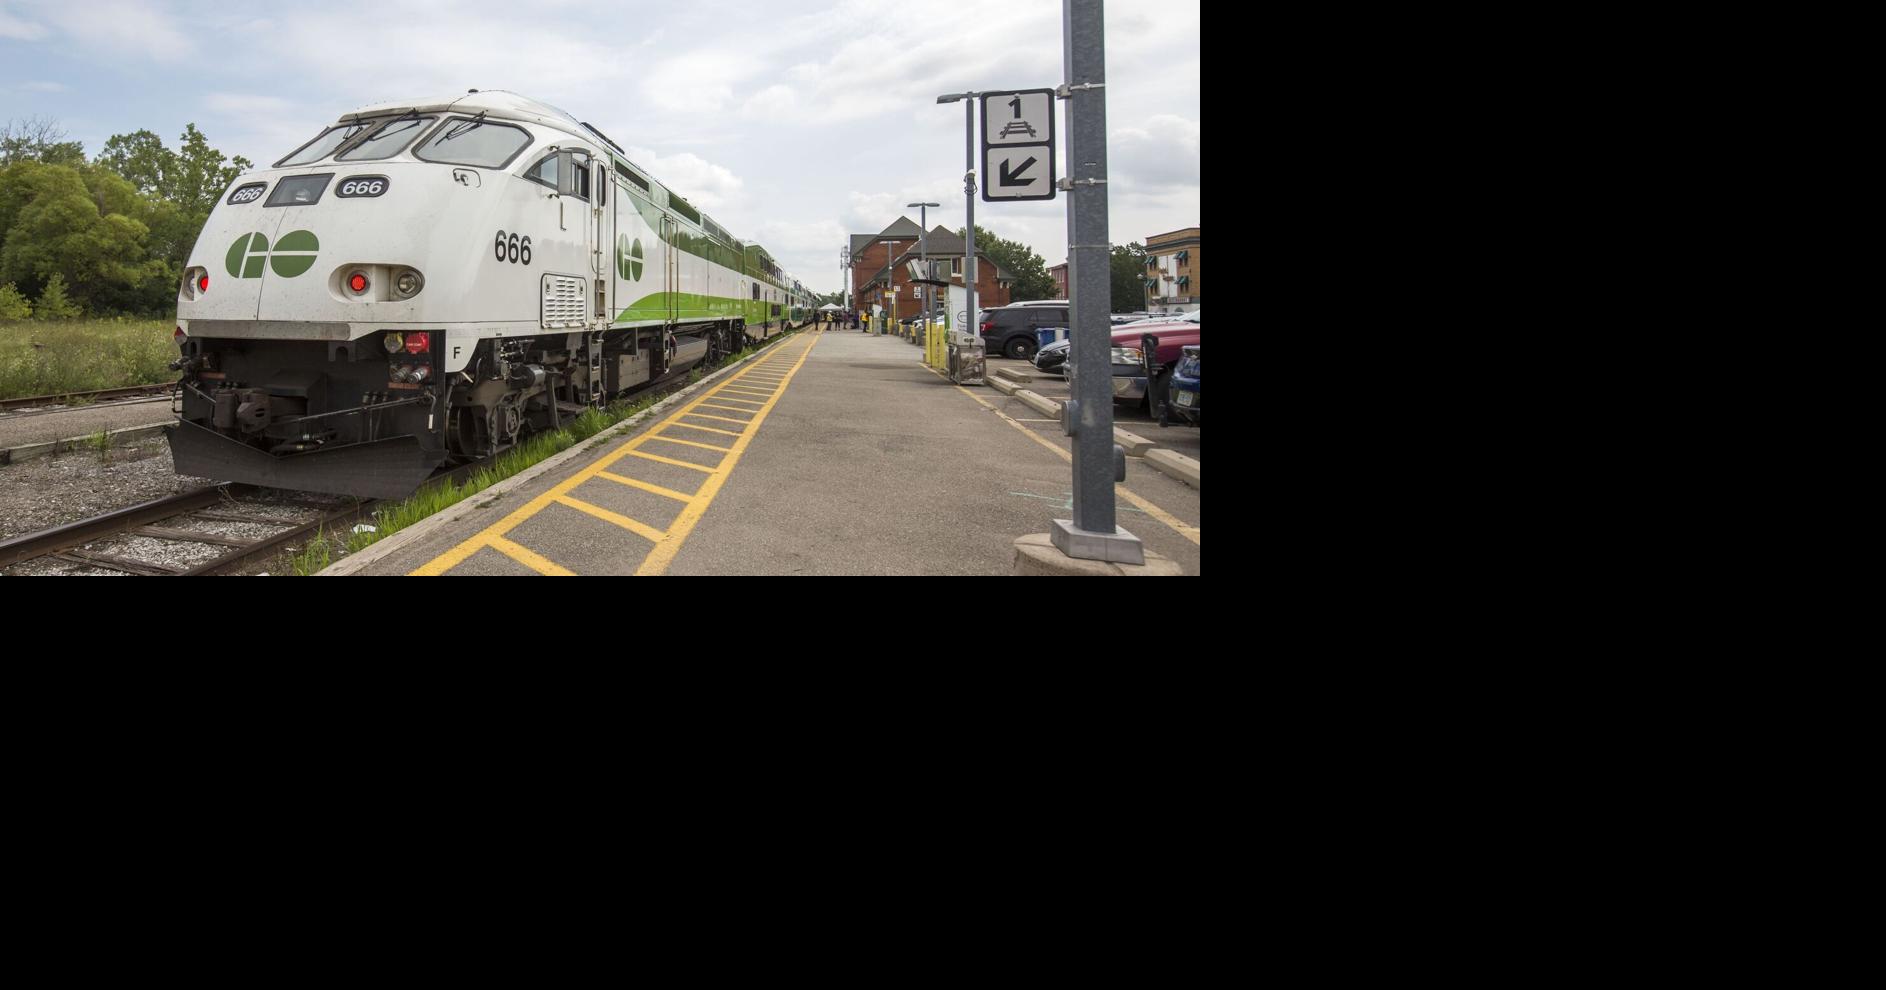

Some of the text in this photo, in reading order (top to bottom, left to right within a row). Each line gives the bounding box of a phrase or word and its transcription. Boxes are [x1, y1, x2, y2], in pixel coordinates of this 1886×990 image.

[1008, 98, 1021, 119] 1
[233, 187, 263, 201] 666
[342, 181, 383, 195] 666
[494, 229, 532, 266] 666
[453, 346, 461, 359] F
